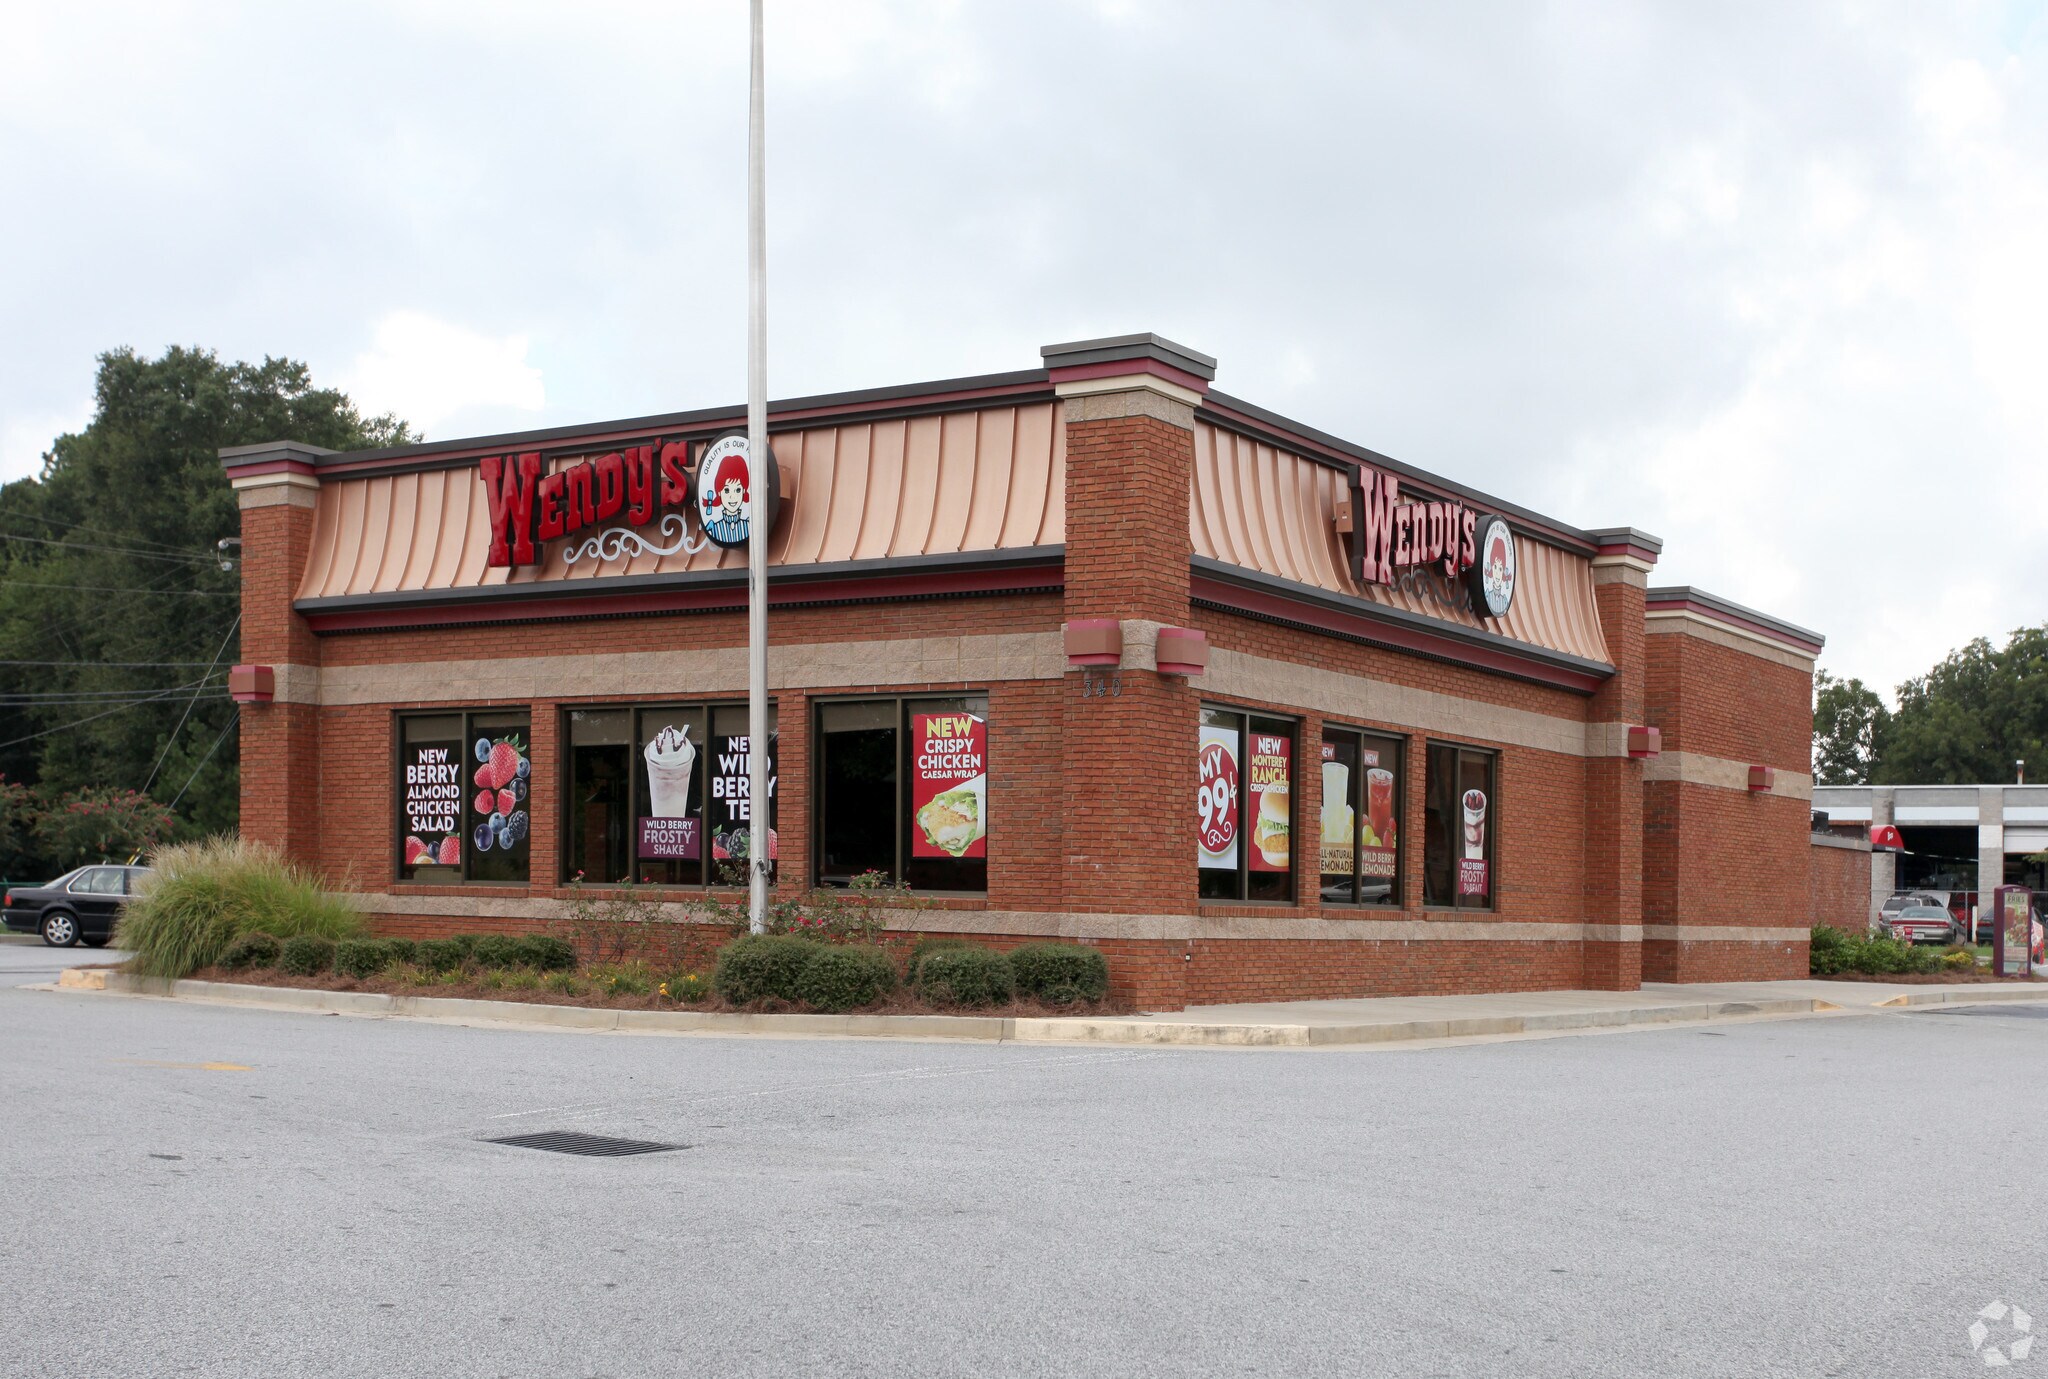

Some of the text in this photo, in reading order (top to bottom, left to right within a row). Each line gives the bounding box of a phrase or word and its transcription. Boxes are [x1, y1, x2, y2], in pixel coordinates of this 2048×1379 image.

[704, 440, 745, 475] QUALITY IS OUR
[480, 437, 690, 568] Wendy's
[1358, 464, 1477, 587] Wendy's
[1083, 679, 1121, 698] 340
[926, 716, 973, 738] NEW
[728, 736, 750, 753] NE
[925, 738, 974, 753] CRISPY
[1258, 737, 1281, 754] NEW
[418, 749, 448, 764] NEW
[918, 754, 981, 769] CHICKEN
[1251, 754, 1287, 768] MONTEREY
[1364, 753, 1377, 764] NEW
[406, 764, 459, 784] BERRY
[921, 769, 977, 779] CAESAR WRAP
[1252, 766, 1286, 783] RANCH
[407, 785, 460, 799] ALMOND
[712, 776, 777, 798] BERY
[1250, 783, 1268, 793] CRISPY
[406, 801, 460, 815] CHICKEN
[726, 800, 750, 820] TE
[411, 816, 455, 832] SALAD
[646, 820, 693, 830] WILD BERRY
[653, 844, 685, 855] SHAKE
[1321, 849, 1353, 860] LL-NATURAL
[1362, 851, 1395, 864] WILD BERRY
[1321, 860, 1353, 872] EMONADE
[1362, 862, 1395, 876] LEMONADE
[1461, 861, 1485, 871] WILD BERRY
